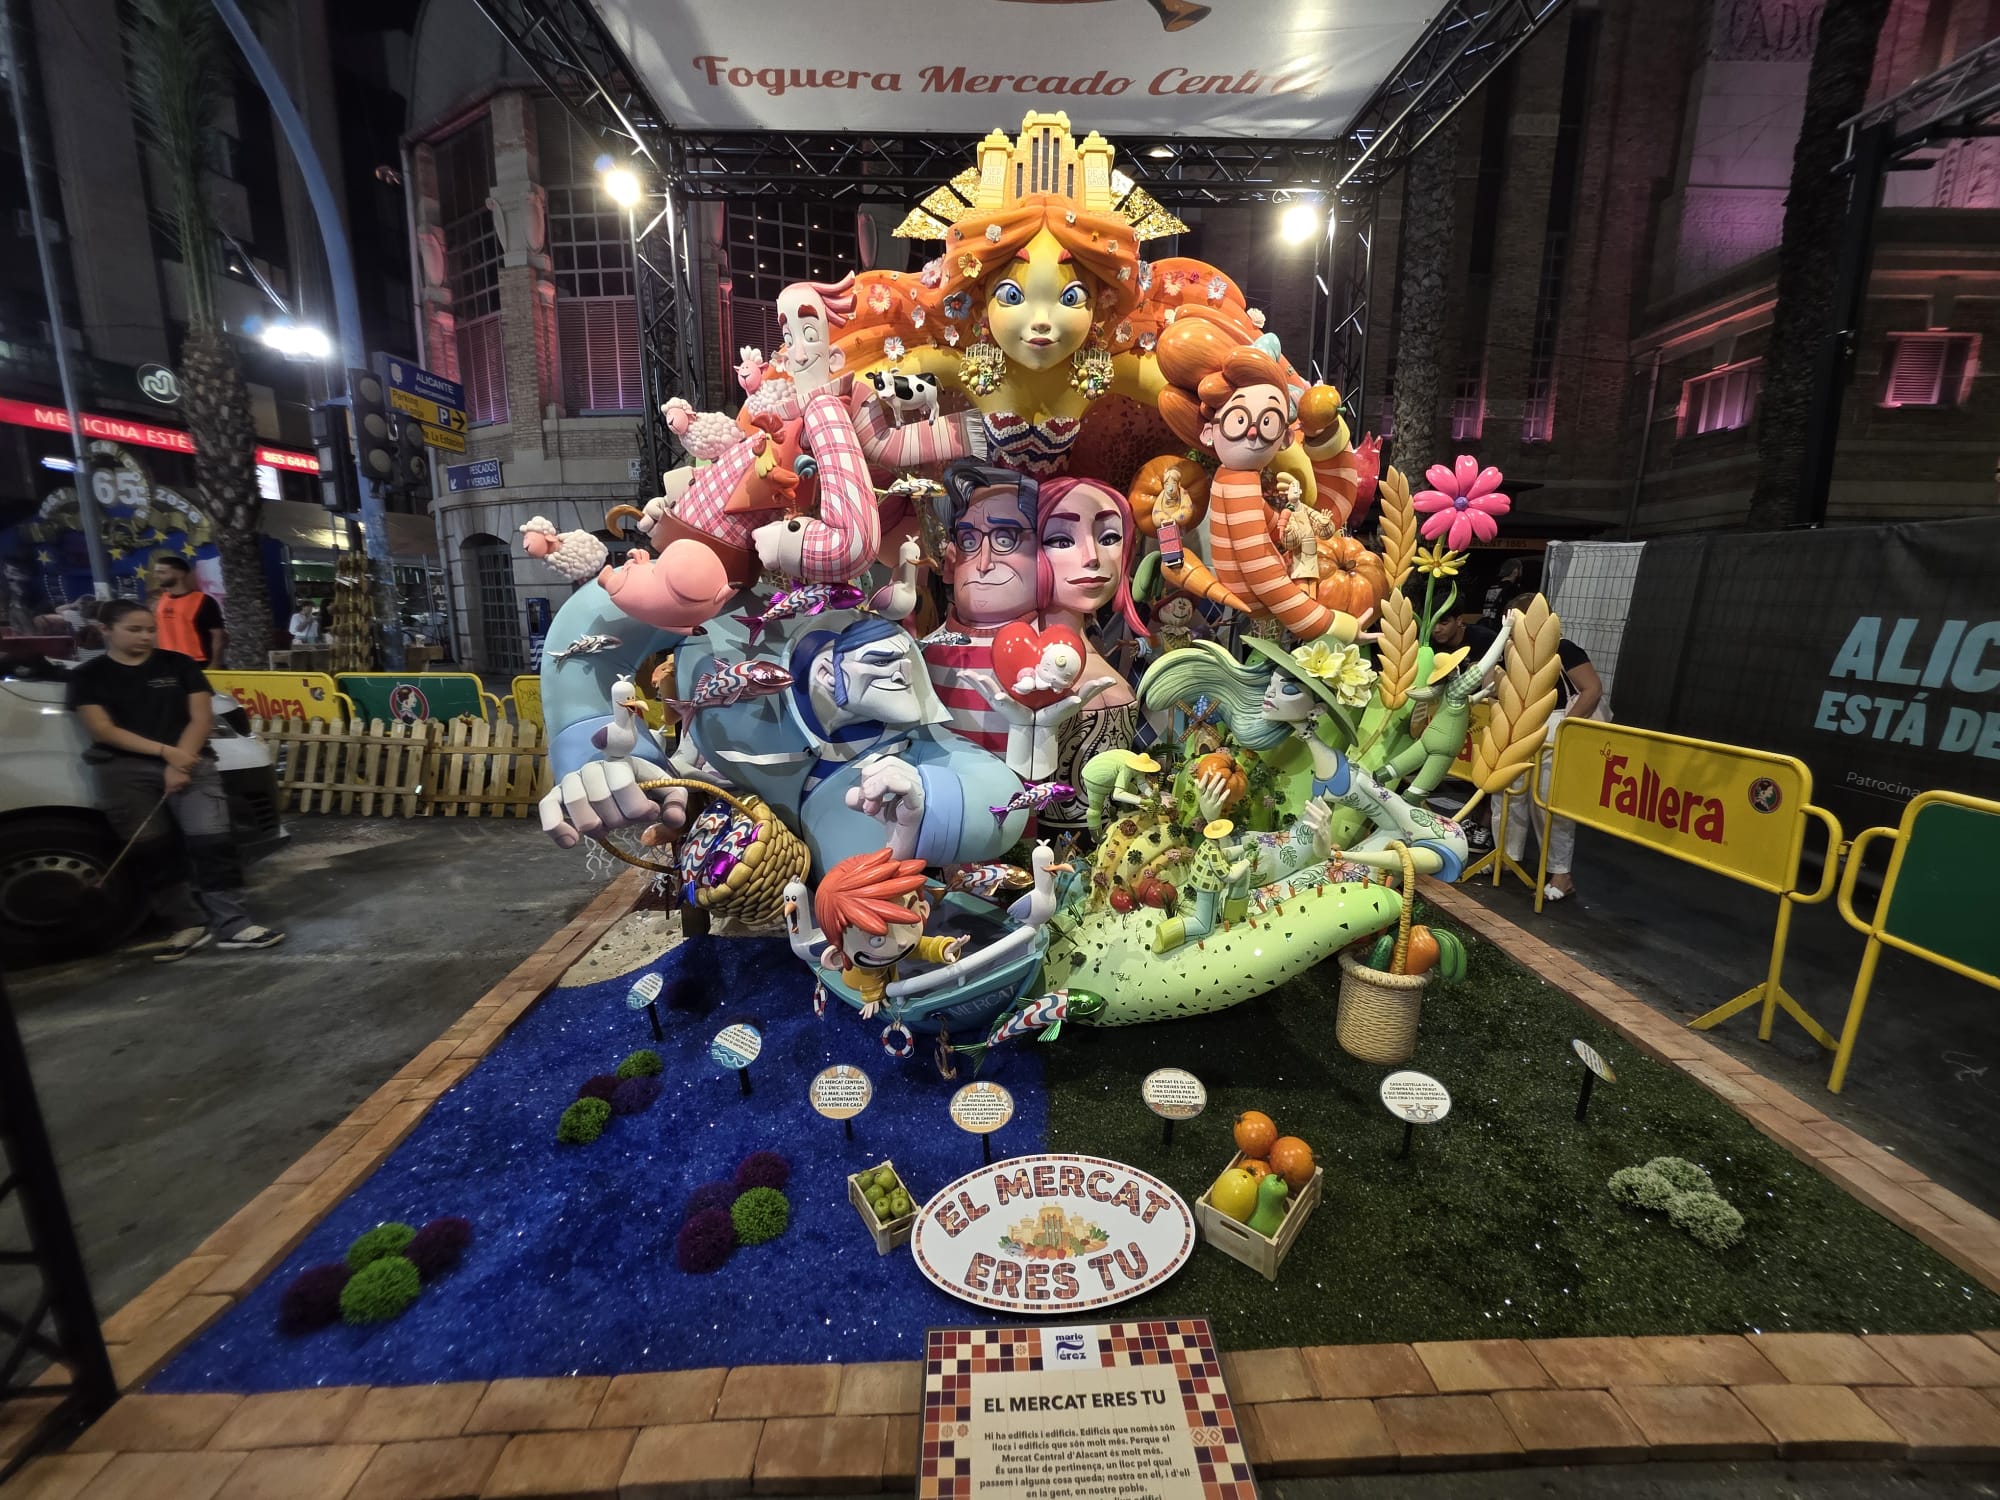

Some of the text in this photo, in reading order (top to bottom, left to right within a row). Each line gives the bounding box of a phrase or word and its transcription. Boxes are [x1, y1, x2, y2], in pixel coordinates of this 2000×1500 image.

[693, 55, 903, 97] Foguera
[918, 65, 1136, 97] Mercado
[416, 372, 455, 395] ALICANTE
[440, 409, 449, 424] P
[34, 409, 194, 451] MEICINA ESTÉ
[262, 451, 286, 465] 865
[286, 455, 308, 468] 644
[469, 462, 497, 475] PESCADOS
[155, 489, 200, 523] 2026
[1815, 690, 1927, 748] ESTÁ
[1600, 755, 1726, 845] Fallera
[948, 985, 1018, 1018] MERCAT
[935, 1165, 1171, 1238] EL MERCAT
[963, 1242, 1148, 1300] ERES TU
[984, 1390, 1166, 1412] EL MERCAT ERES TU
[984, 1432, 994, 1440] Hi
[996, 1432, 1006, 1440] ha
[1008, 1430, 1038, 1439] edificis
[1045, 1429, 1079, 1438] edificis.
[1080, 1427, 1111, 1437] Edificis
[1113, 1428, 1128, 1437] que
[1130, 1425, 1158, 1434] només
[1160, 1424, 1175, 1432] són
[992, 1442, 1012, 1451] llocs
[1019, 1440, 1050, 1450] edificis
[1052, 1441, 1068, 1450] que
[1070, 1439, 1085, 1448] són
[1087, 1438, 1106, 1447] molt
[1108, 1437, 1129, 1446] més.
[1162, 1435, 1170, 1443] el
[1002, 1447, 1163, 1463] Mercat Central d'Alacant és molt més.
[1025, 1464, 1040, 1473] llar
[1042, 1463, 1053, 1473] de
[1055, 1461, 1105, 1473] pertinença,
[1119, 1459, 1135, 1469] lloc
[1137, 1458, 1151, 1469] pel
[1152, 1457, 1172, 1469] qual
[980, 1479, 1014, 1490] passem
[1020, 1476, 1051, 1487] alguna
[1053, 1477, 1073, 1485] cosa
[1074, 1473, 1105, 1485] queda;
[1107, 1472, 1135, 1482] nostra
[1150, 1470, 1164, 1480] ell,
[1026, 1483, 1147, 1499] en la gent, en nostre poble.
